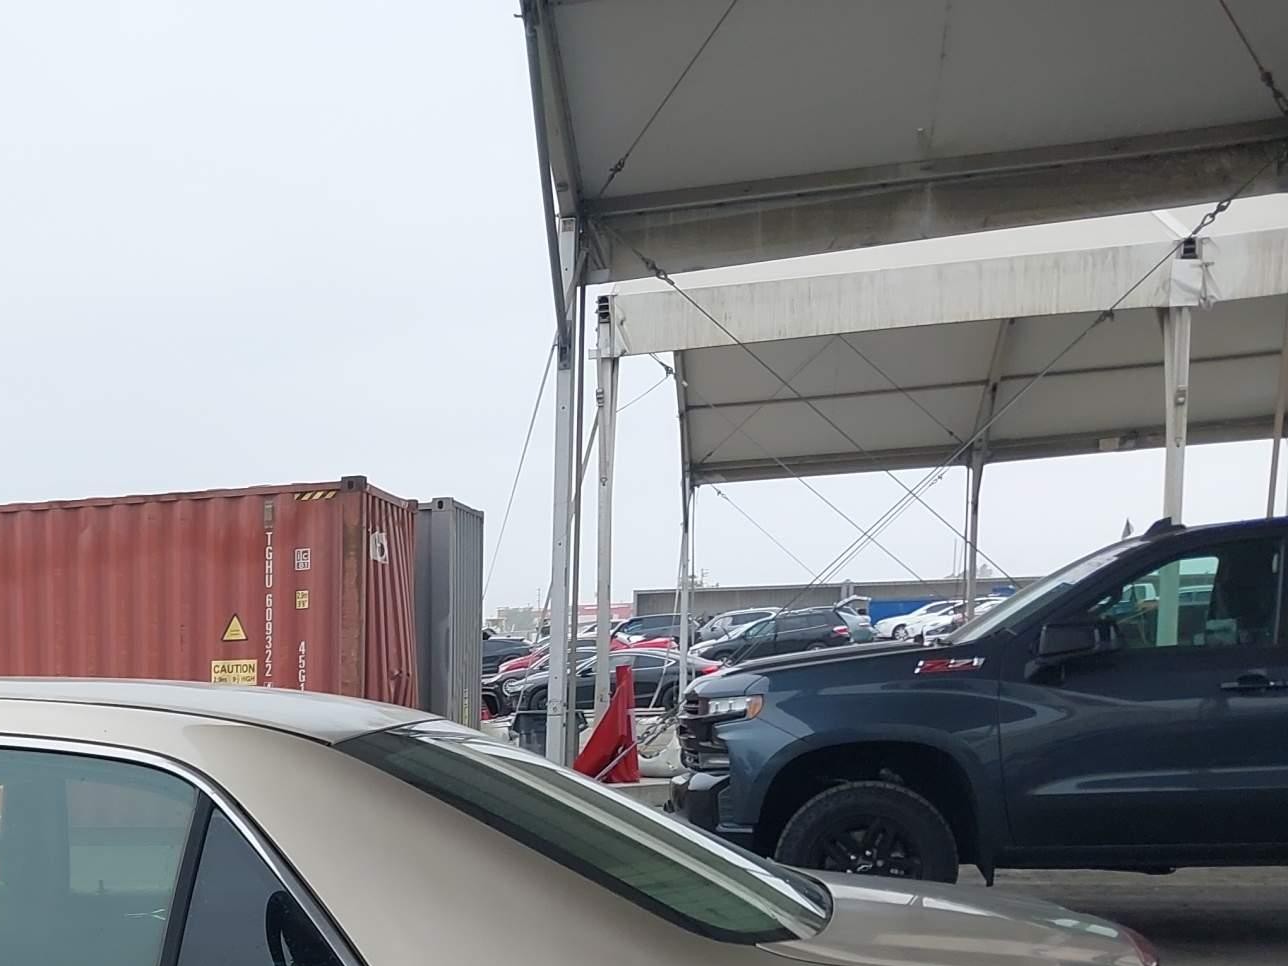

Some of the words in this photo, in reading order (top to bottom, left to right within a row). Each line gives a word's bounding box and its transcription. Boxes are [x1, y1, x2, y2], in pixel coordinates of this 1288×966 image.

[265, 532, 273, 588] TGHU
[265, 594, 273, 677] 609322
[213, 663, 256, 674] CAUTION
[298, 640, 306, 691] 45G1
